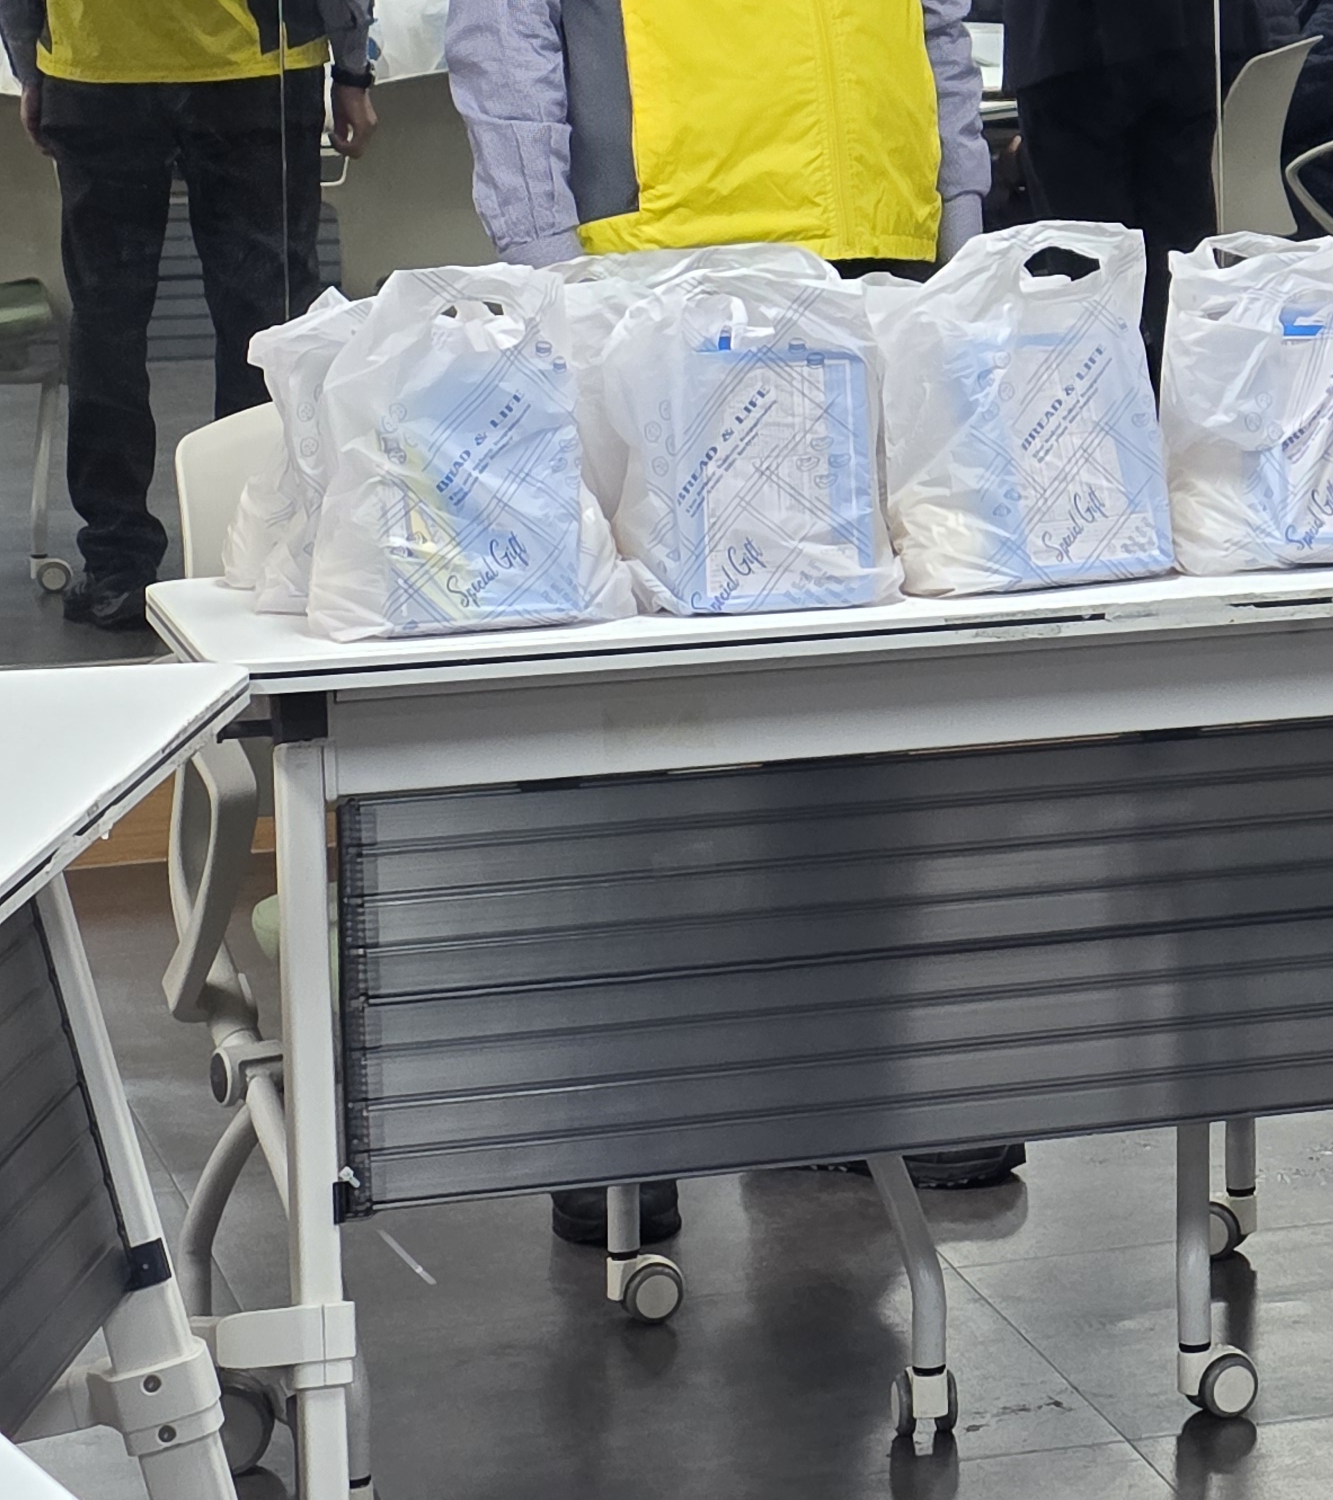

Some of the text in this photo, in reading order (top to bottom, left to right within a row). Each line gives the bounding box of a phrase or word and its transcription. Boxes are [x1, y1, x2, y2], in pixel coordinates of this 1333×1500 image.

[735, 386, 771, 424] LIFE
[1021, 398, 1063, 451] BREAD
[1075, 343, 1106, 381] LIFE
[1073, 484, 1109, 524] Gift
[728, 536, 767, 576] Gift
